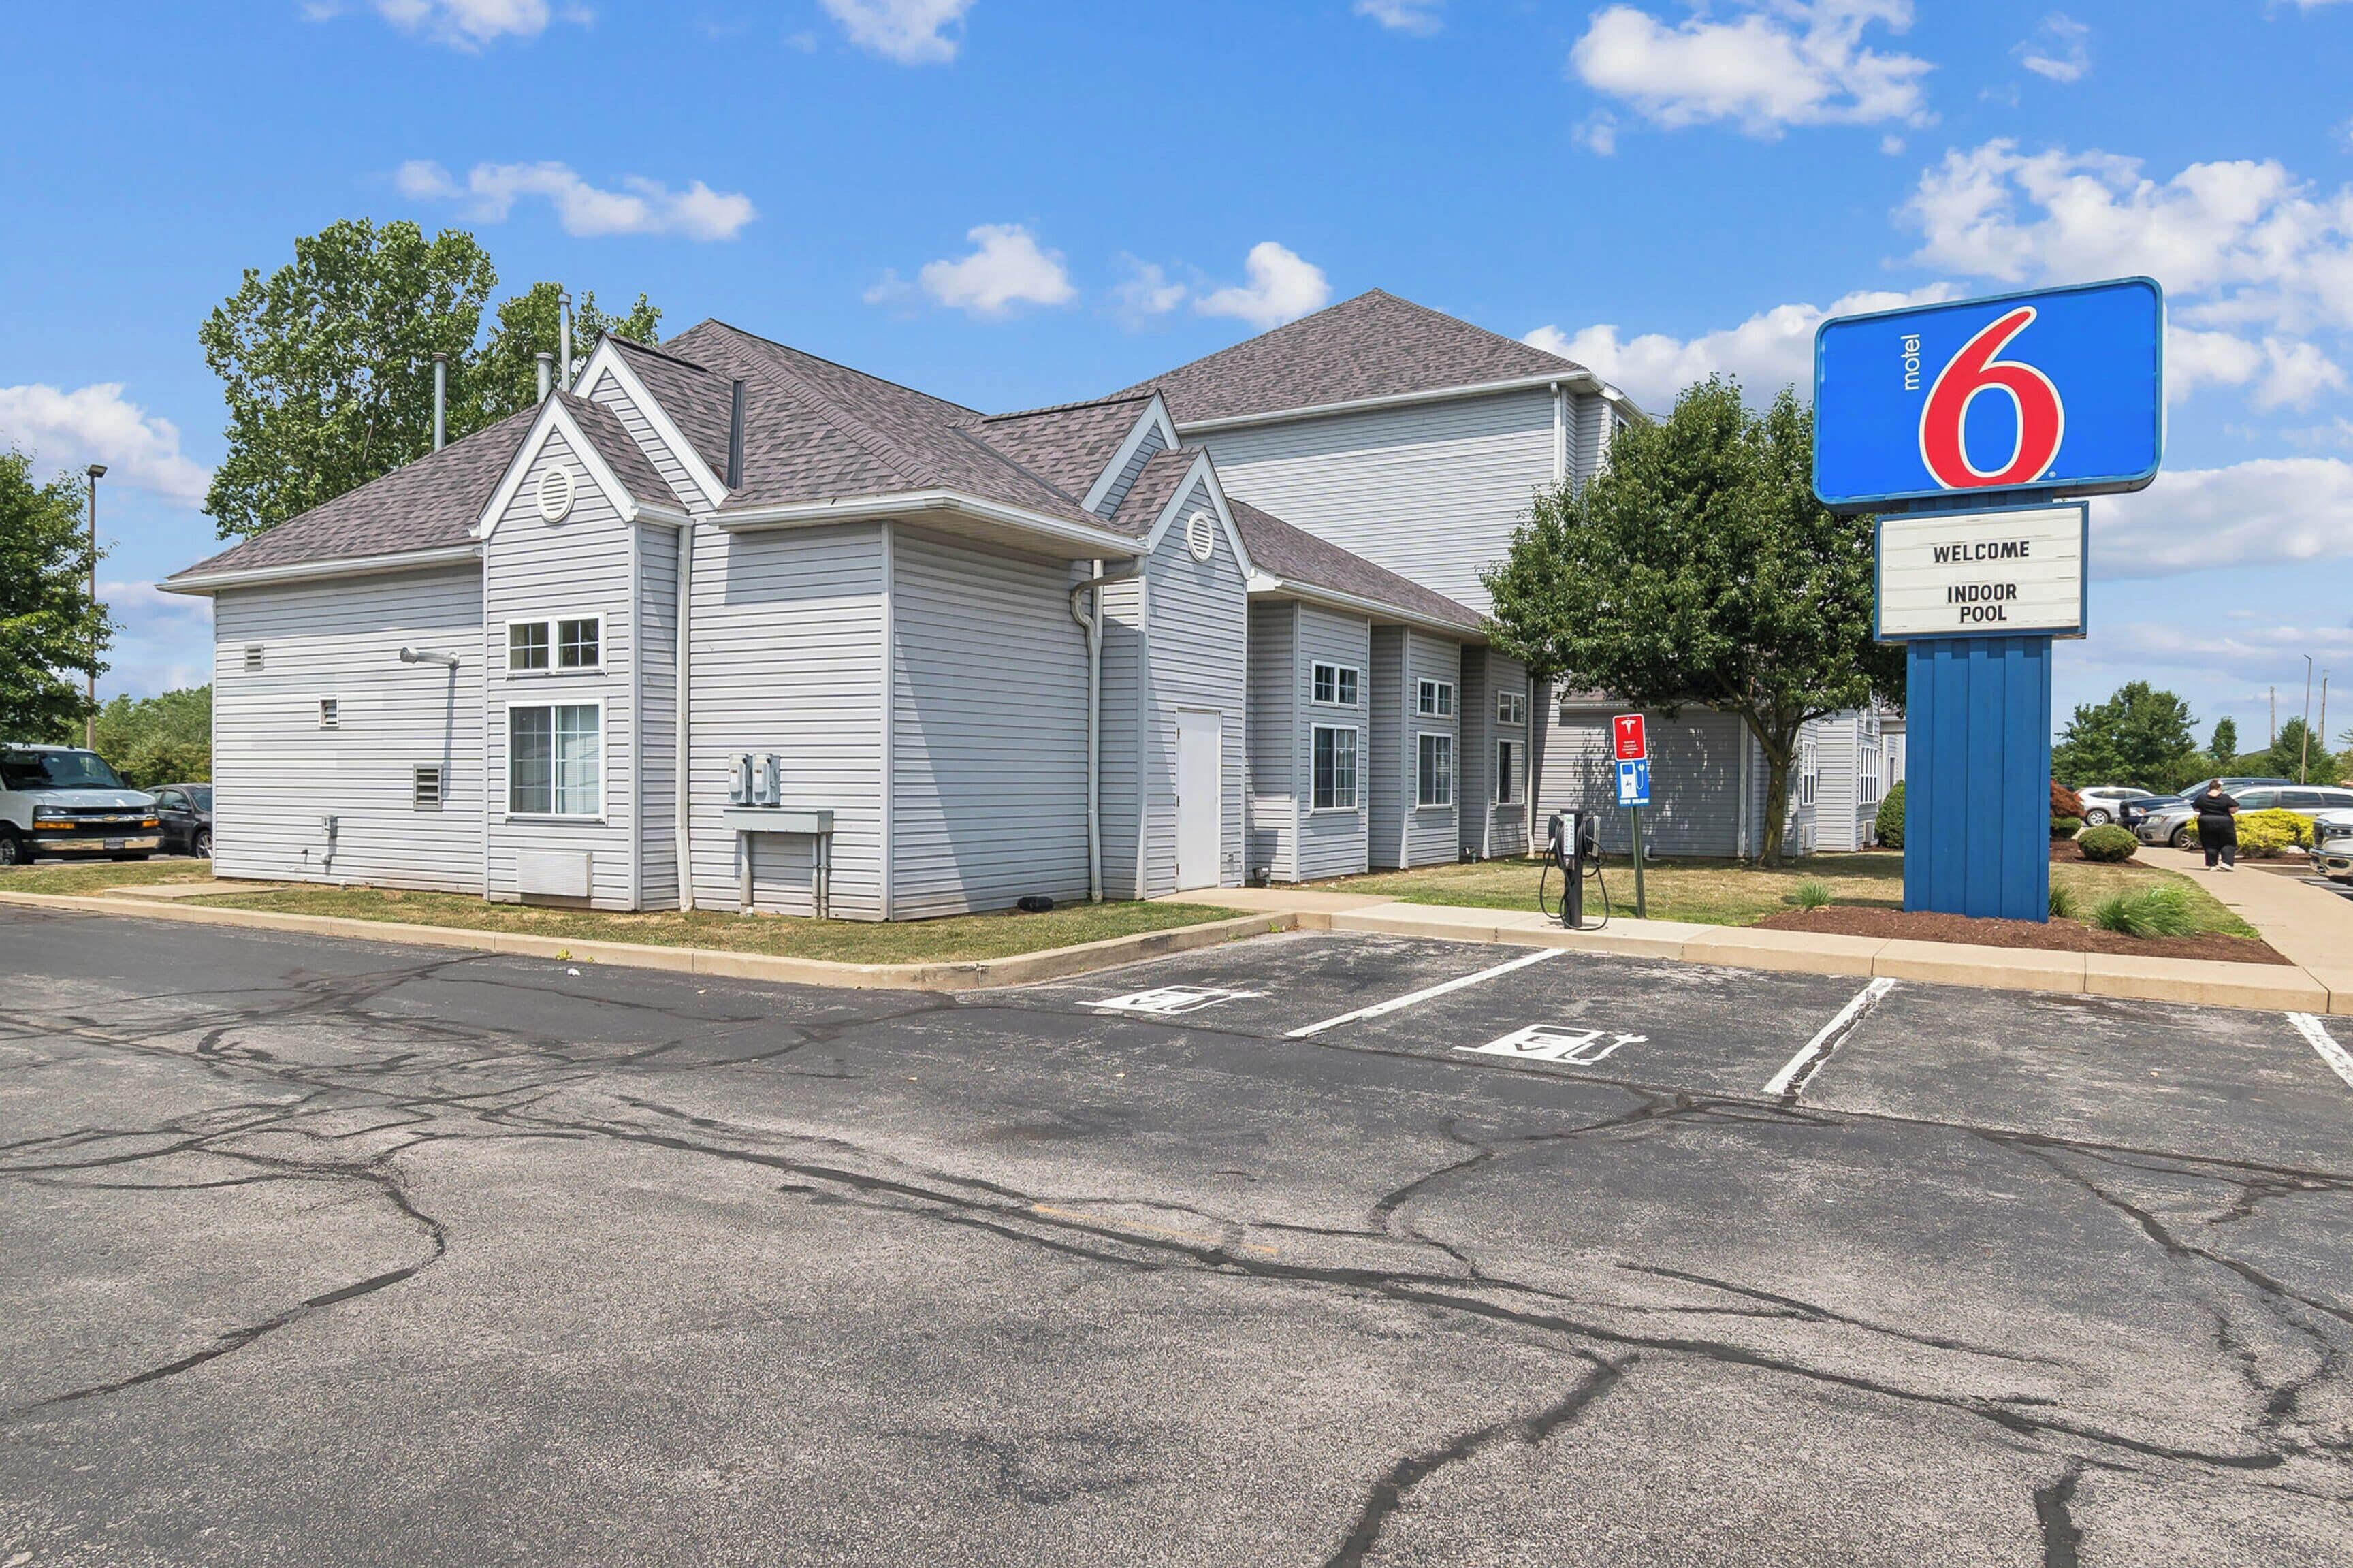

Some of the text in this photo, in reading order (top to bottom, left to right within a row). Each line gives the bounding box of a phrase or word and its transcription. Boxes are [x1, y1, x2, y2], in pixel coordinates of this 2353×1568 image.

[1900, 306, 2065, 490] motel 6
[1933, 541, 2030, 563] WELCOME
[1947, 583, 2017, 603] INDOOR
[1959, 605, 2007, 623] POOL
